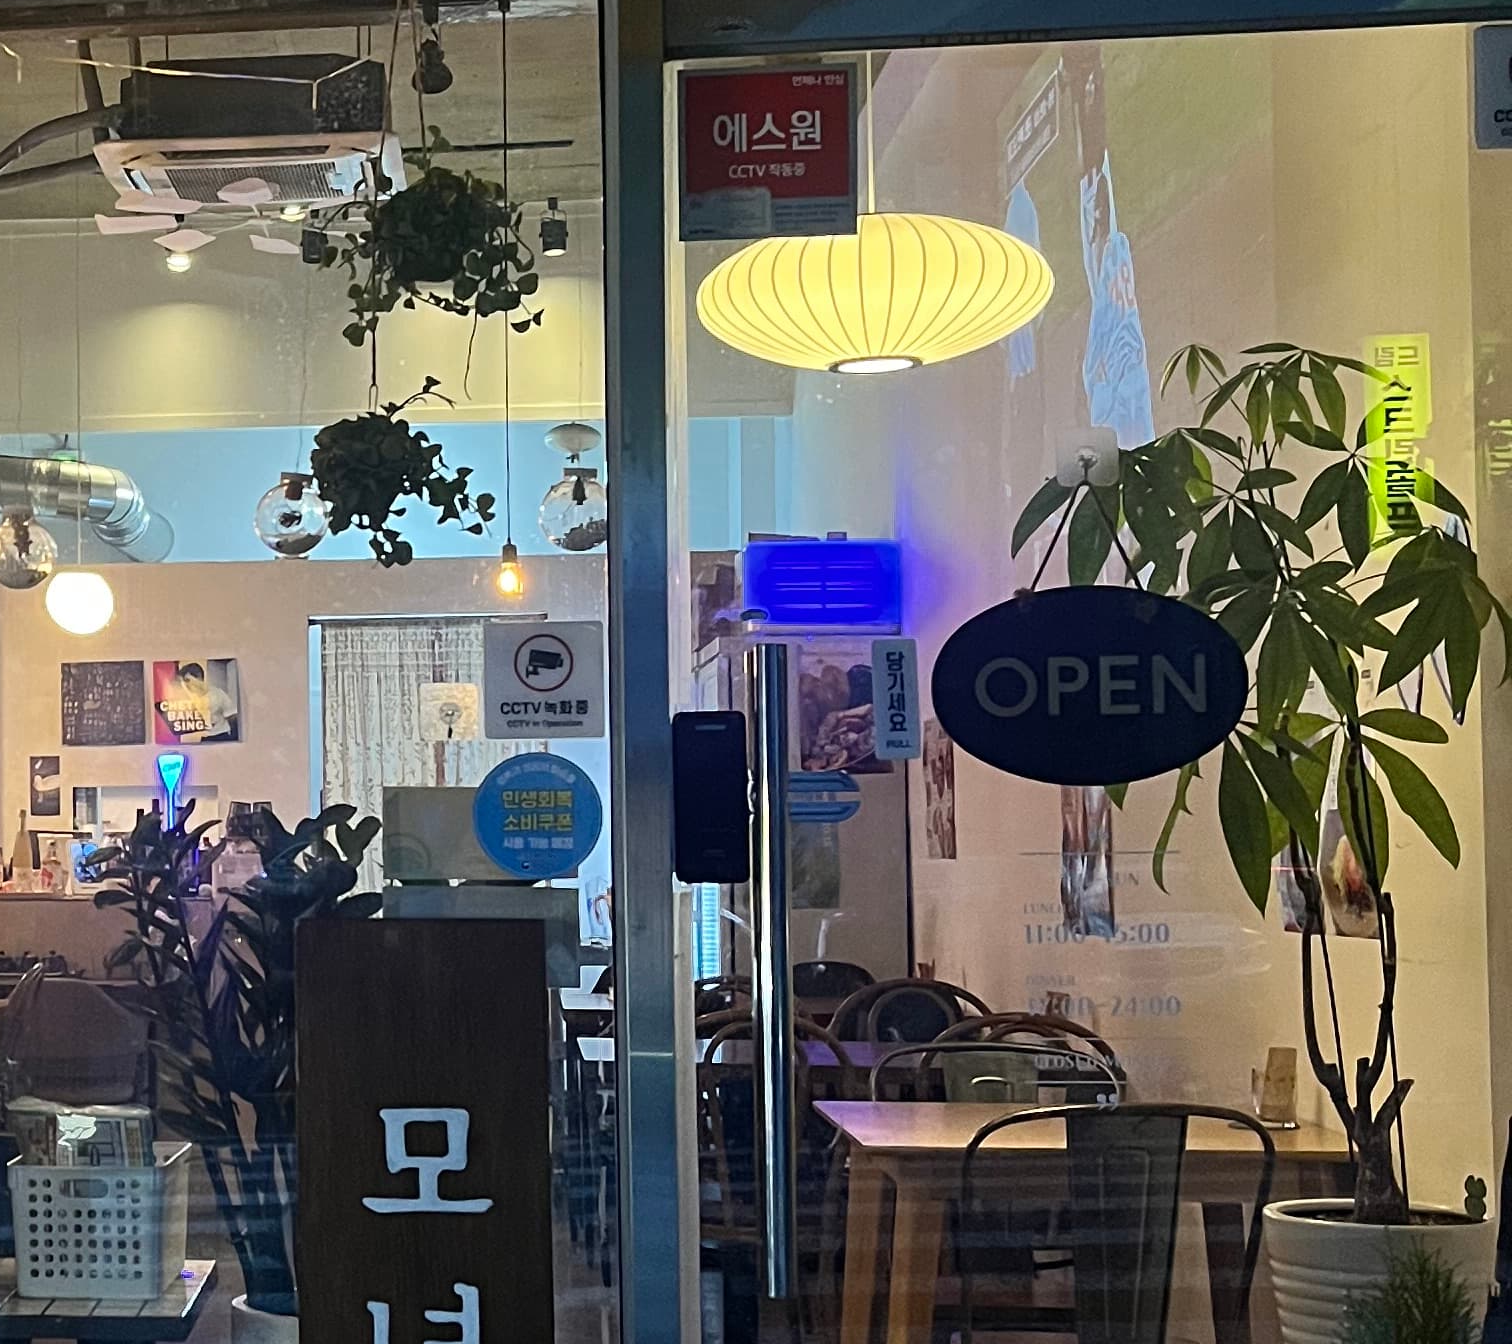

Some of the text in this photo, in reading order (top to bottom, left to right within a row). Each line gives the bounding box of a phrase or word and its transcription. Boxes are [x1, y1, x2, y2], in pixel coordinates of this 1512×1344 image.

[712, 109, 822, 153] 에스원
[728, 162, 806, 179] CCTV 작동중
[885, 651, 908, 733] 당기세요
[973, 653, 1208, 719] OPEN
[500, 699, 589, 715] CCTV 녹화 중
[173, 720, 213, 733] SINGS
[502, 789, 573, 809] 민생회복
[502, 813, 574, 832] 소비쿠폰
